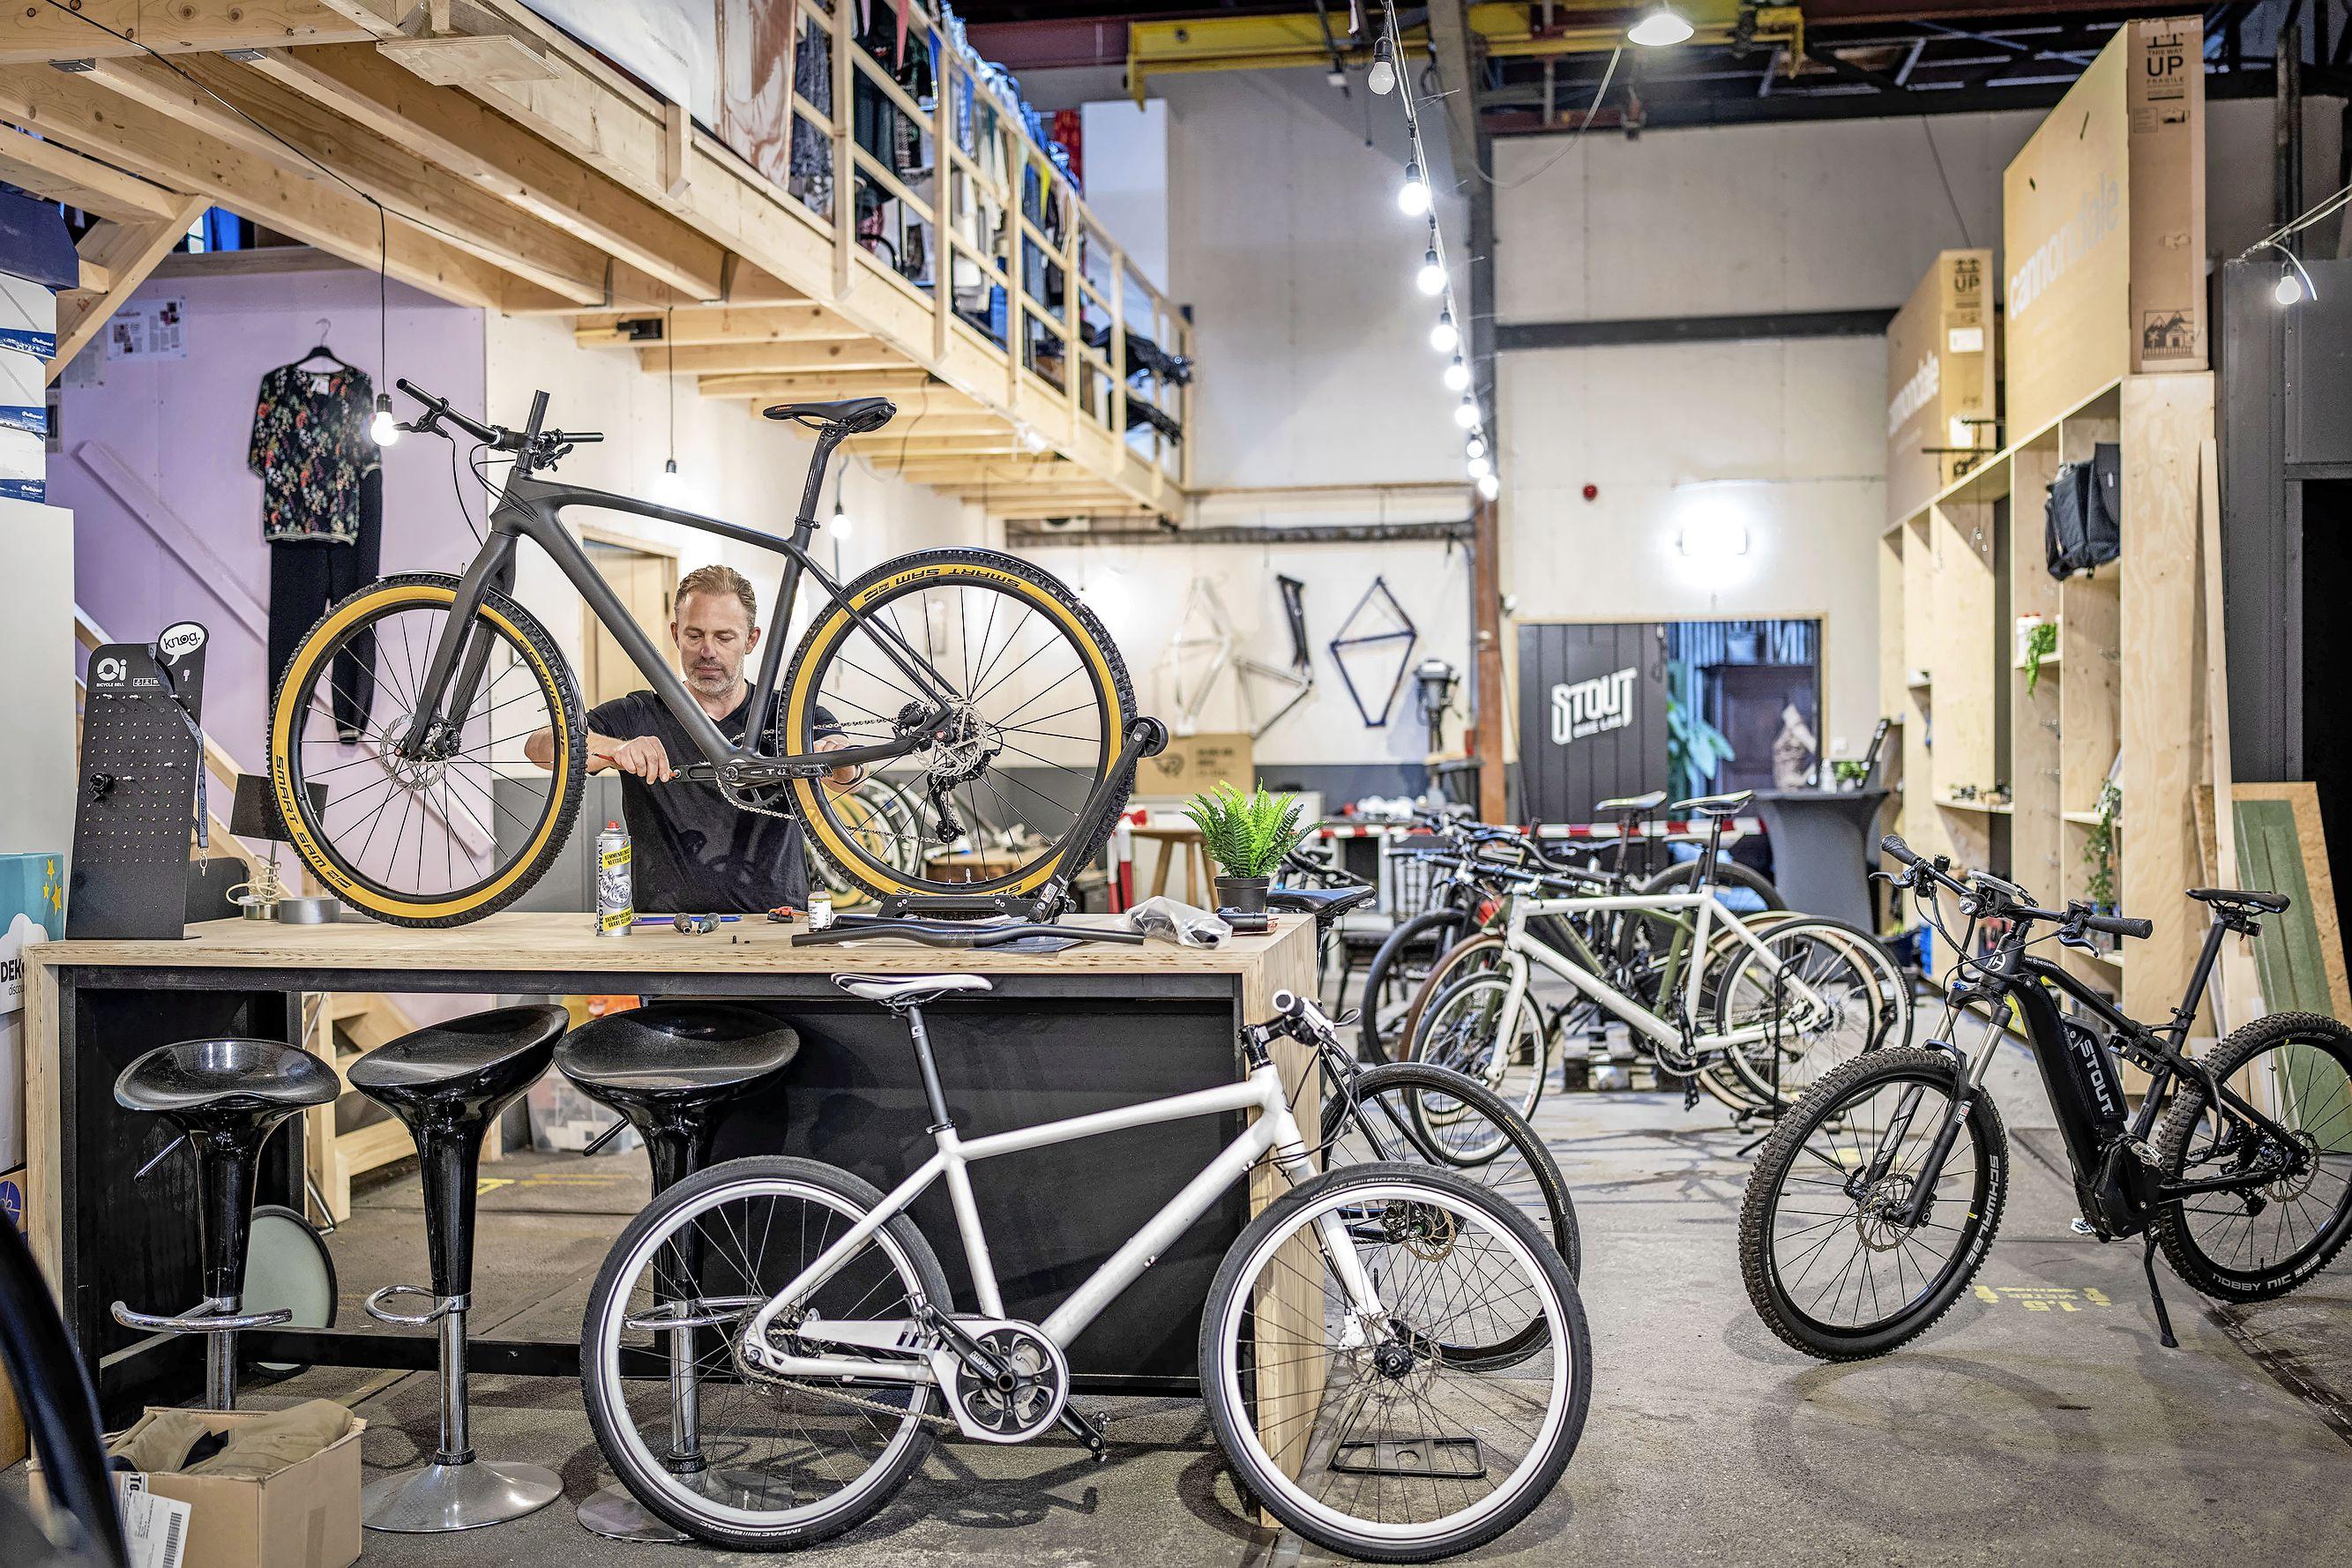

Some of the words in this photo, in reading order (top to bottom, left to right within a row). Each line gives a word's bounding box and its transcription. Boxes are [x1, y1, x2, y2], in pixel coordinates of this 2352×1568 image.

[2147, 56, 2184, 77] UP
[2009, 170, 2121, 321] cannondale
[1953, 274, 1981, 293] UP
[895, 567, 940, 586] SAM
[948, 567, 1021, 589] SMART
[1552, 667, 1638, 745] STOUT
[275, 754, 299, 825] SMART
[295, 831, 327, 868] SAM
[2079, 1039, 2115, 1112] STOUT
[1966, 1154, 2000, 1267] SCHWALBE
[2212, 1272, 2261, 1291] NOBBY
[2266, 1273, 2292, 1289] NIC
[699, 1520, 743, 1535] BIGPAC
[761, 1527, 802, 1537] IMPAC
